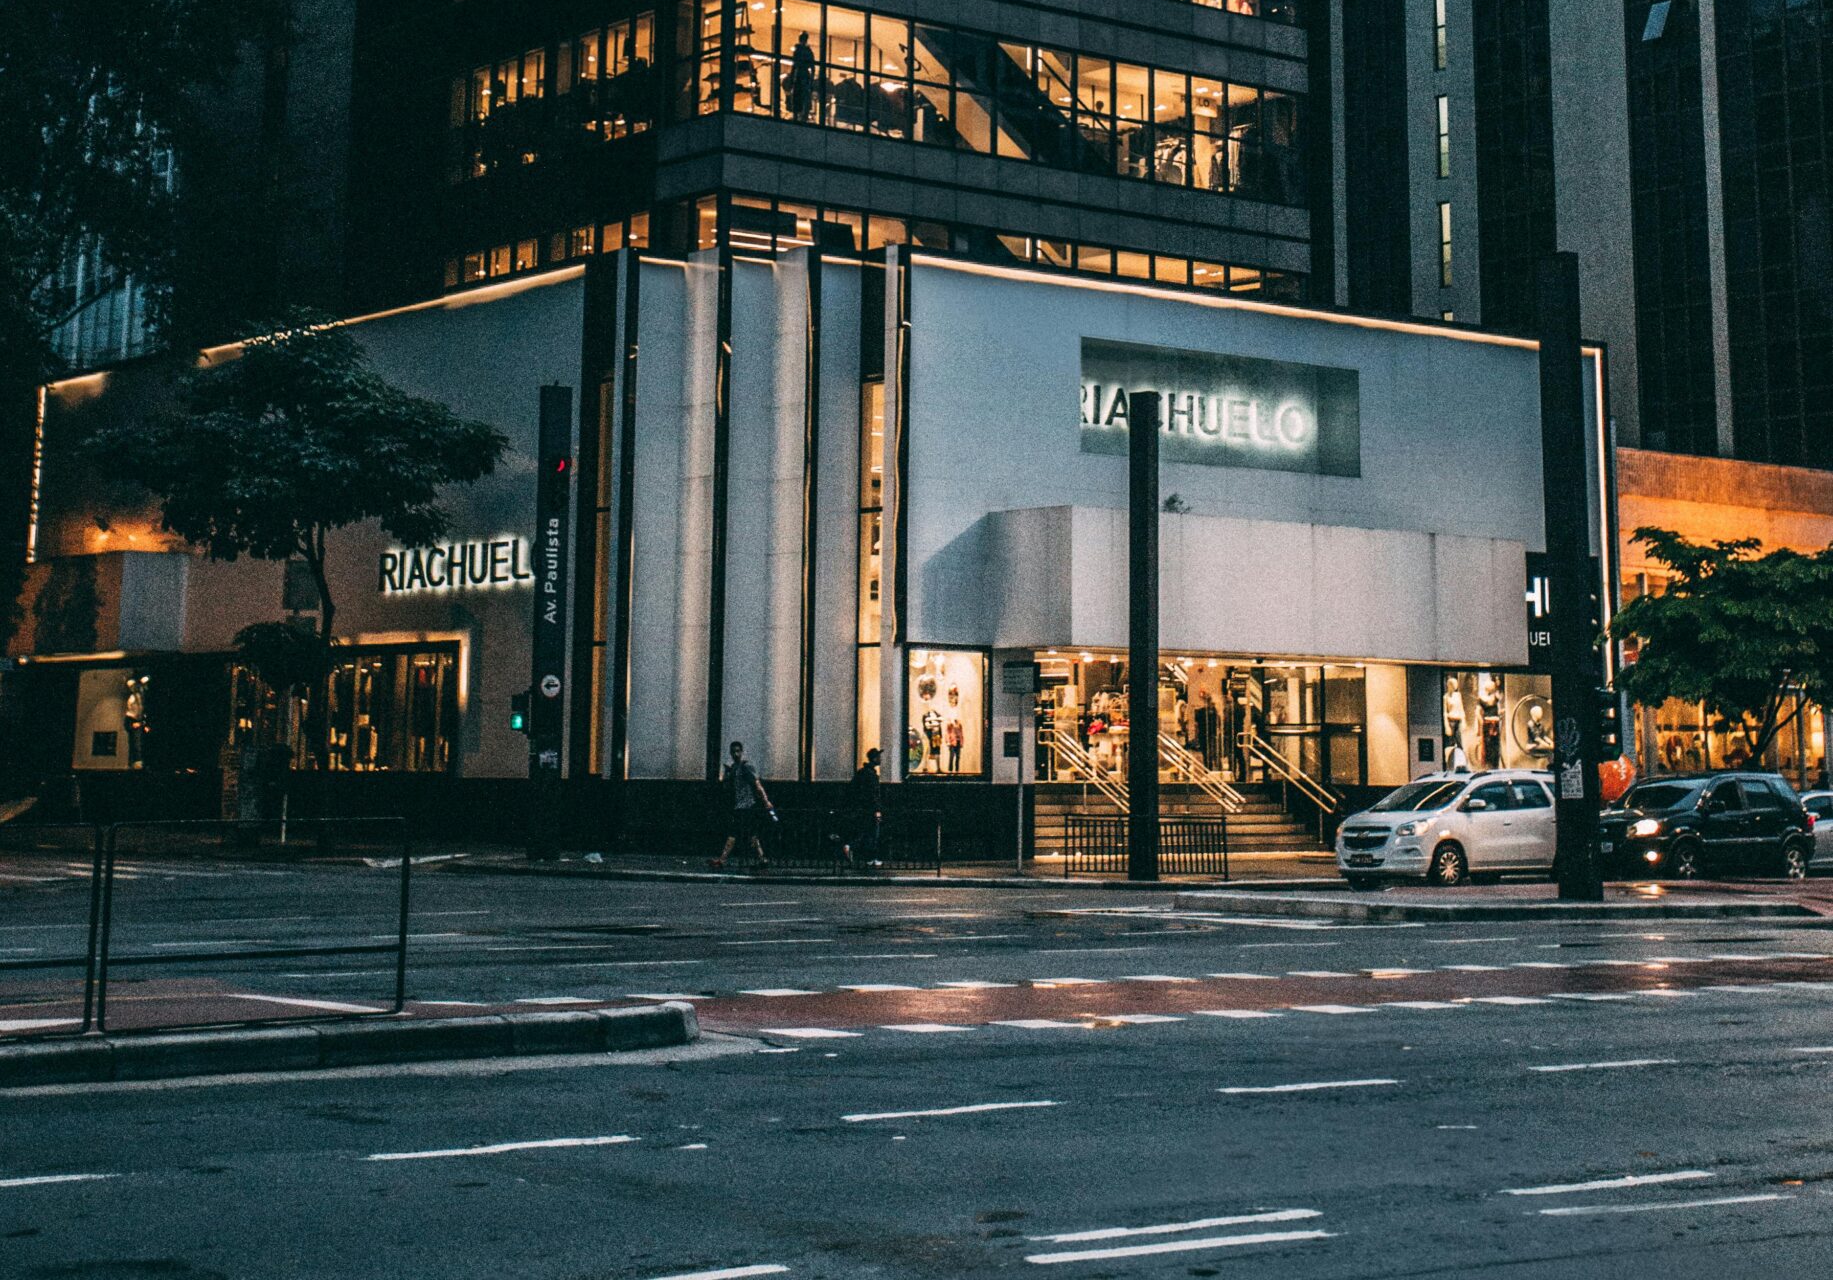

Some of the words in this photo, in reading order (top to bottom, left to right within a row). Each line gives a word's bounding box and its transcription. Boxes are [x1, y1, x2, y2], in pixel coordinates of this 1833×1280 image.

[1080, 385, 1313, 445] IAHUELO
[379, 538, 538, 593] RIACHUEL
[544, 518, 560, 594] Paulista
[543, 599, 557, 624] Av.
